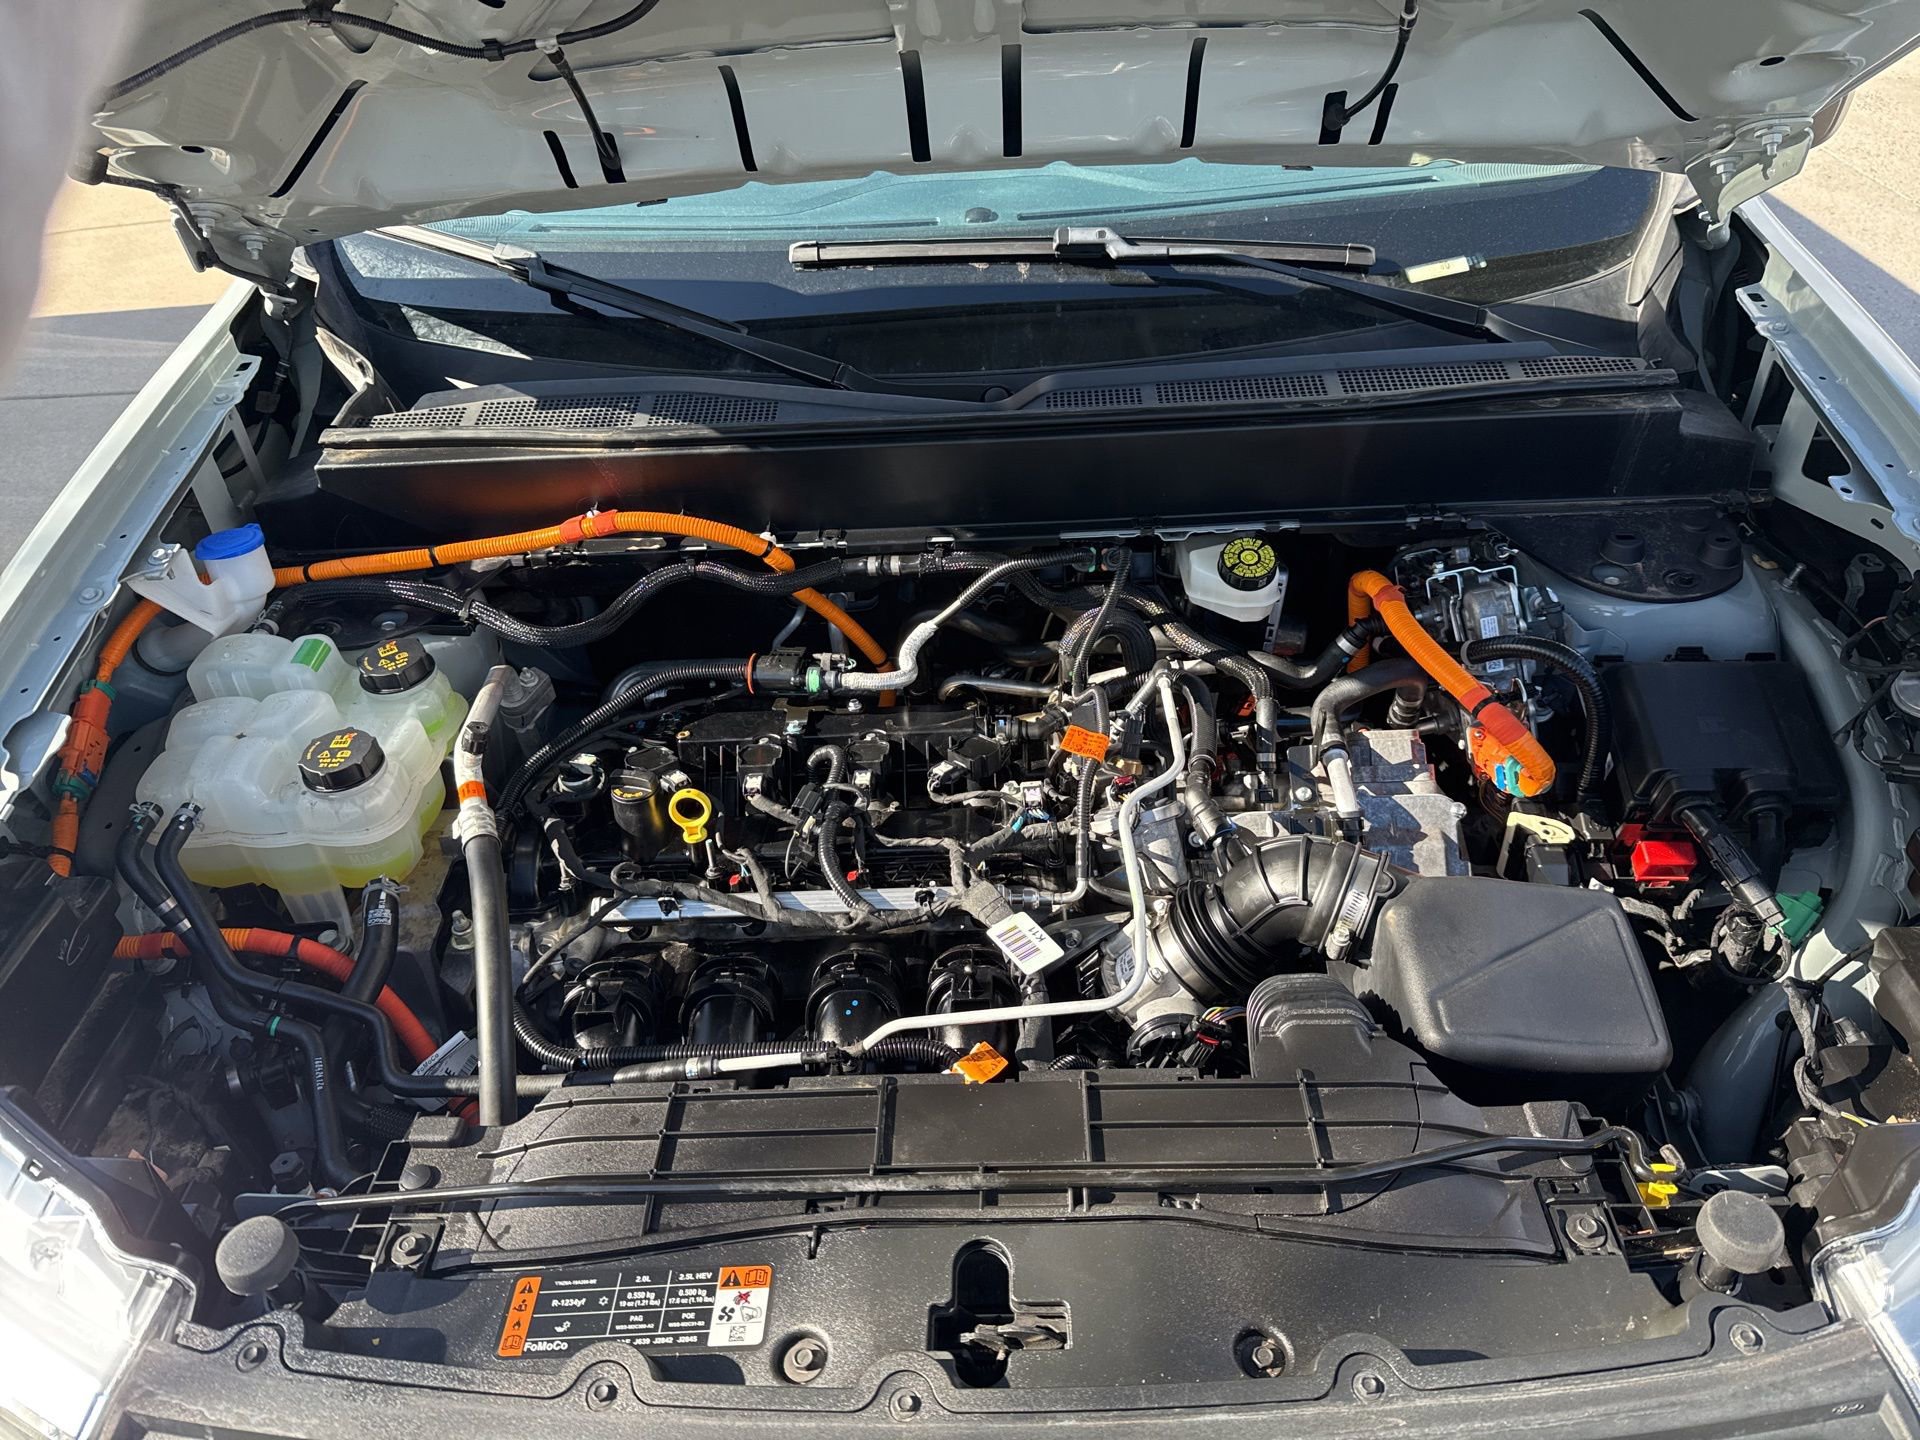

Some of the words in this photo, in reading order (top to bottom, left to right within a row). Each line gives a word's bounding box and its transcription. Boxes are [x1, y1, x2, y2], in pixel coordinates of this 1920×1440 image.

[1028, 926, 1047, 942] K11
[416, 1053, 440, 1075] FoMoCo
[635, 1275, 652, 1283] 2.0L
[678, 1273, 695, 1281] 2.5L
[695, 1272, 713, 1280] HEV
[646, 1291, 656, 1300] kg
[678, 1289, 697, 1297] 0.500
[697, 1288, 707, 1297] kg
[551, 1298, 586, 1307] R-1234yf
[523, 1341, 568, 1352] FoMoCo
